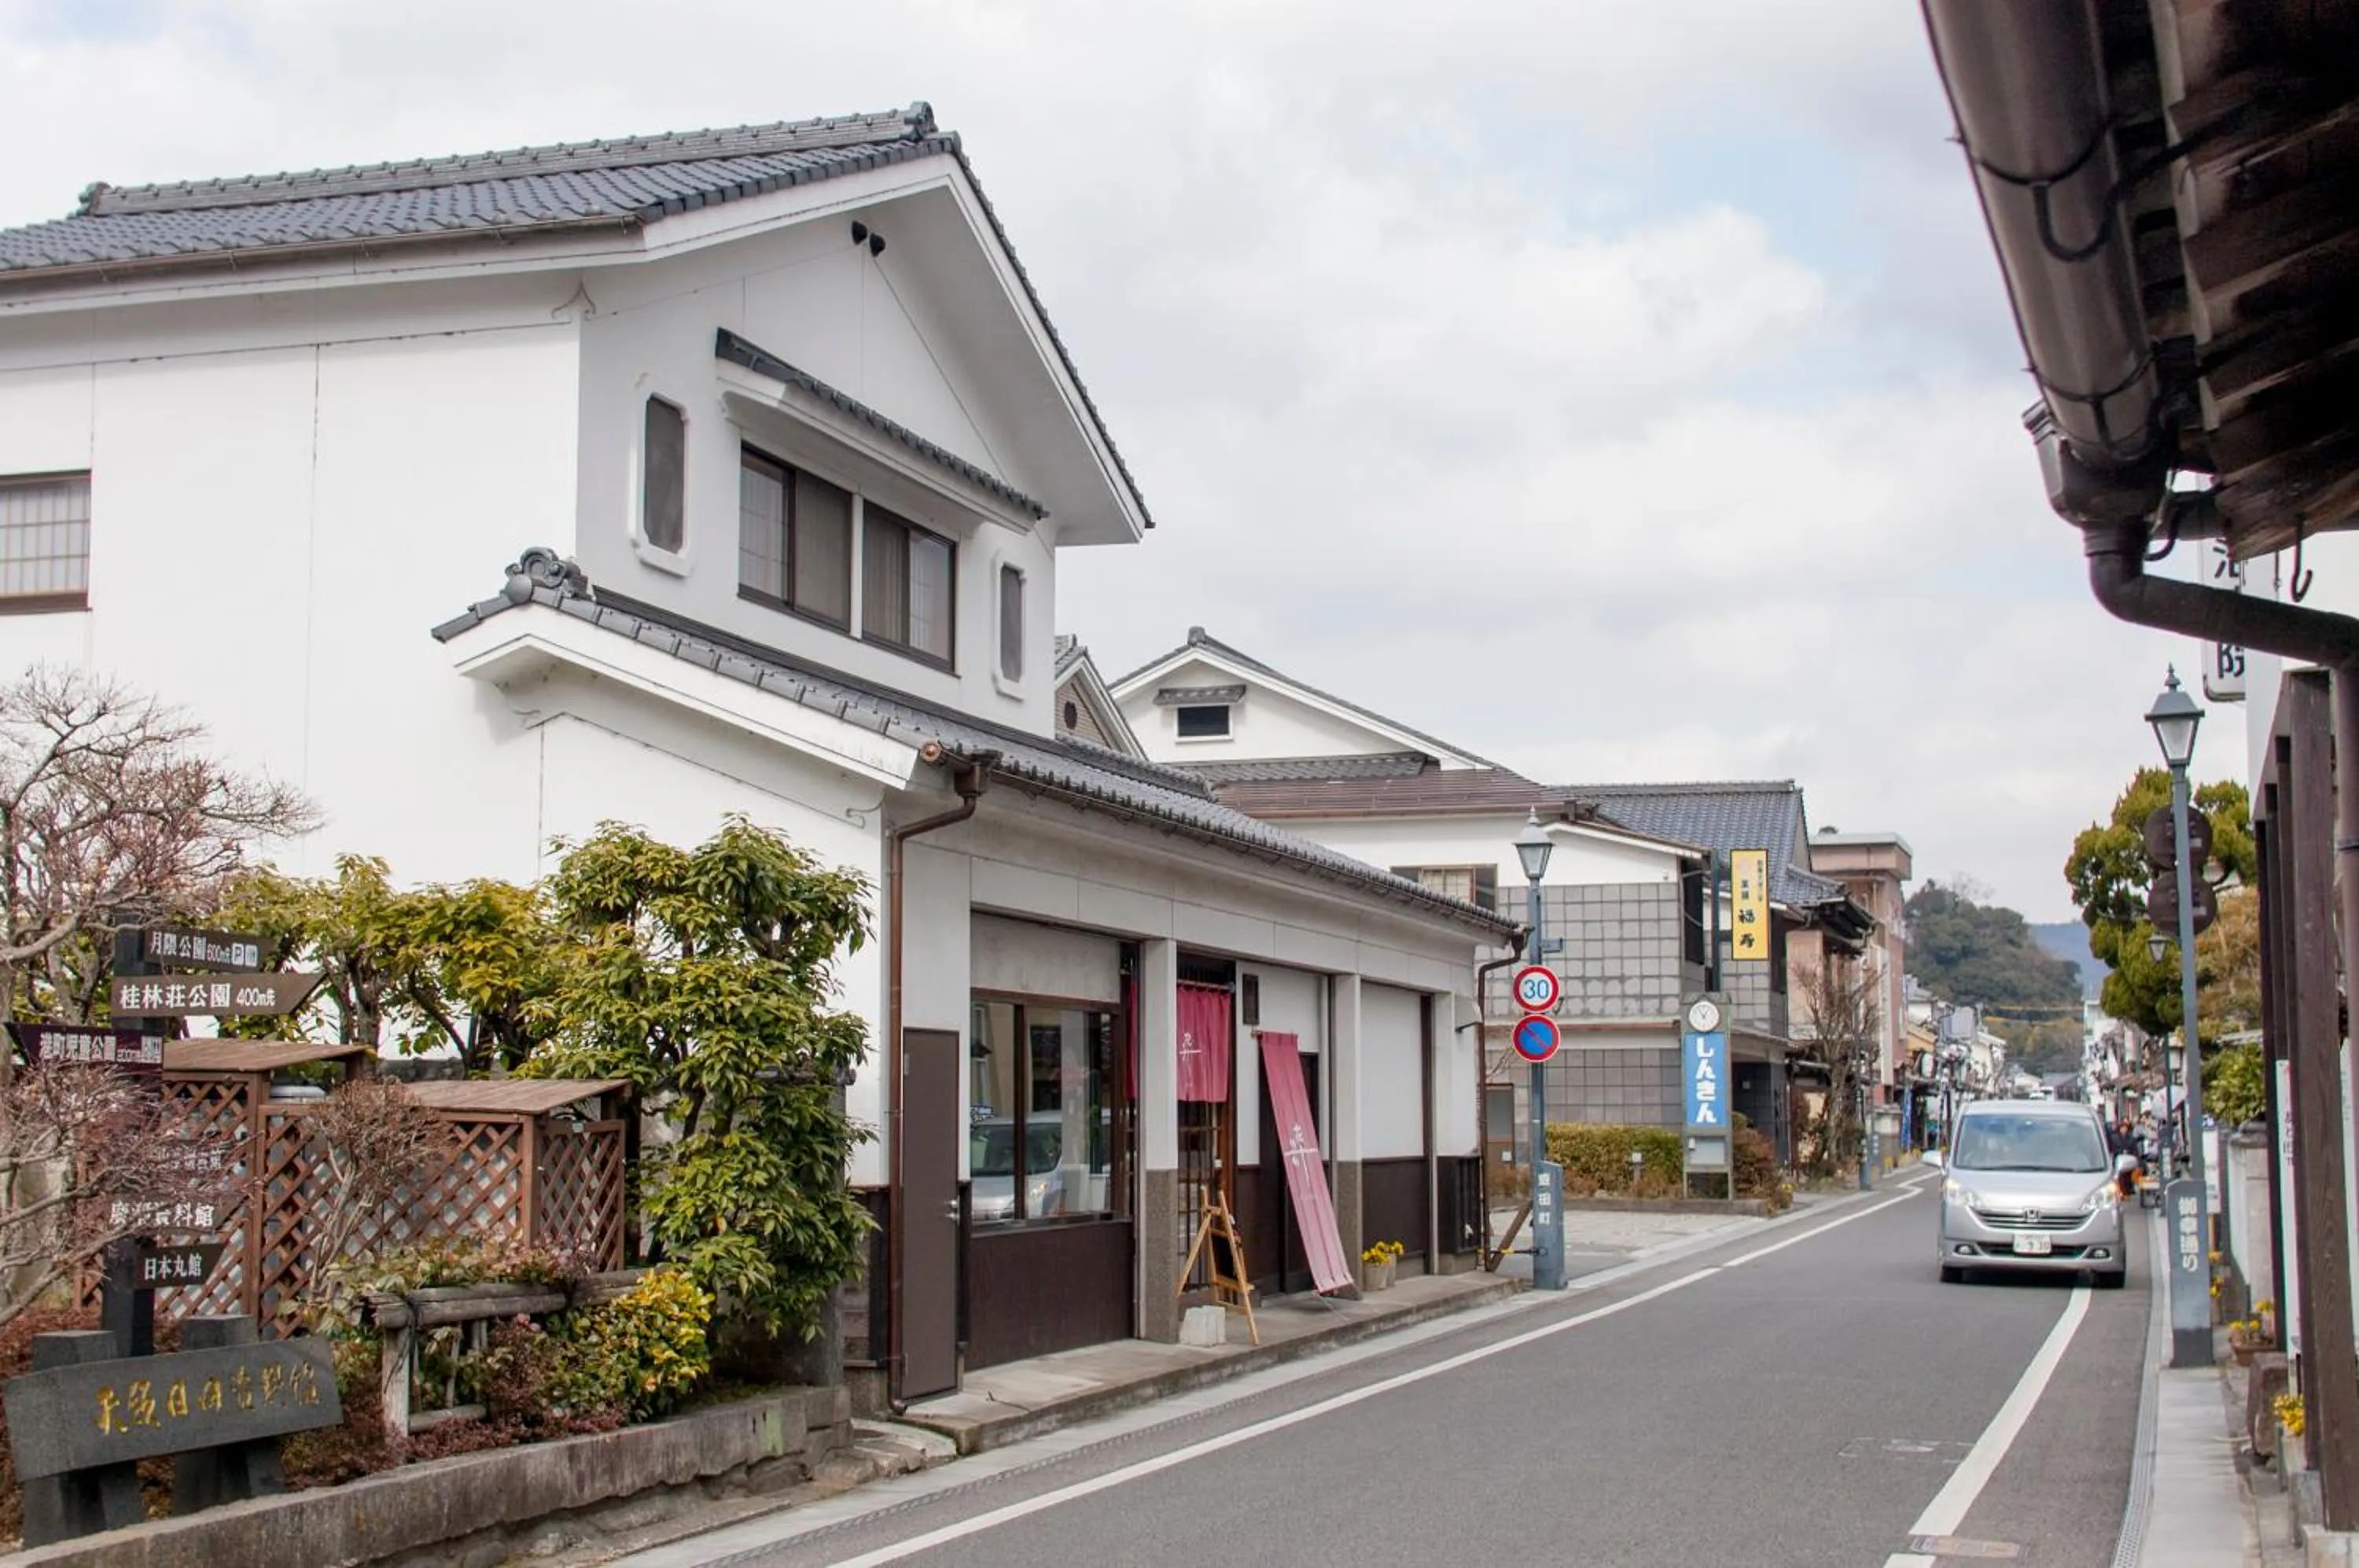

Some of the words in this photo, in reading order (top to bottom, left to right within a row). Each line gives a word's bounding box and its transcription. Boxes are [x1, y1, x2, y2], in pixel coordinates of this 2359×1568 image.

[120, 982, 231, 1010] 桂林荘公園
[1524, 978, 1549, 1000] 30
[1695, 1036, 1717, 1124] しんきん
[145, 1253, 203, 1280] 日本丸館
